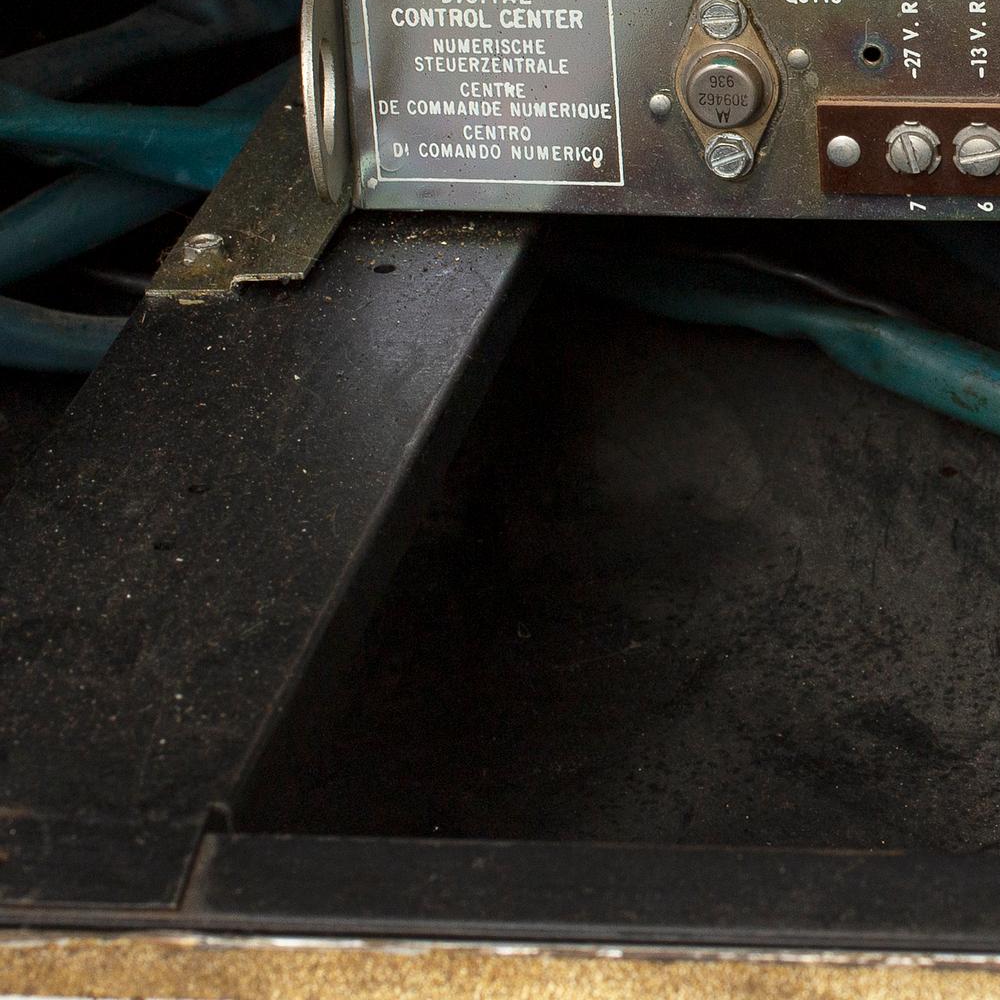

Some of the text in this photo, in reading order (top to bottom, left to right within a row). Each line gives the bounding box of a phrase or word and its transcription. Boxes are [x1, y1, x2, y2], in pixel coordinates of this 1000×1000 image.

[390, 7, 584, 29] CONTROL CENTER
[901, 21, 921, 42] V.
[969, 21, 987, 42] V.
[432, 38, 547, 55] NUMERISCHE
[414, 56, 569, 75] STEUERZENTRALE
[902, 48, 922, 80] -27
[969, 47, 989, 80] -13
[459, 81, 527, 100] CENTRE
[709, 75, 735, 89] 936
[378, 99, 613, 120] DE COMMANDE NUMERIQUE
[698, 93, 749, 108] 309462
[462, 124, 532, 142] CENTRO
[392, 142, 604, 162] DI COMANDO NUMERICO
[908, 200, 927, 214] 7
[976, 200, 994, 214] 6
